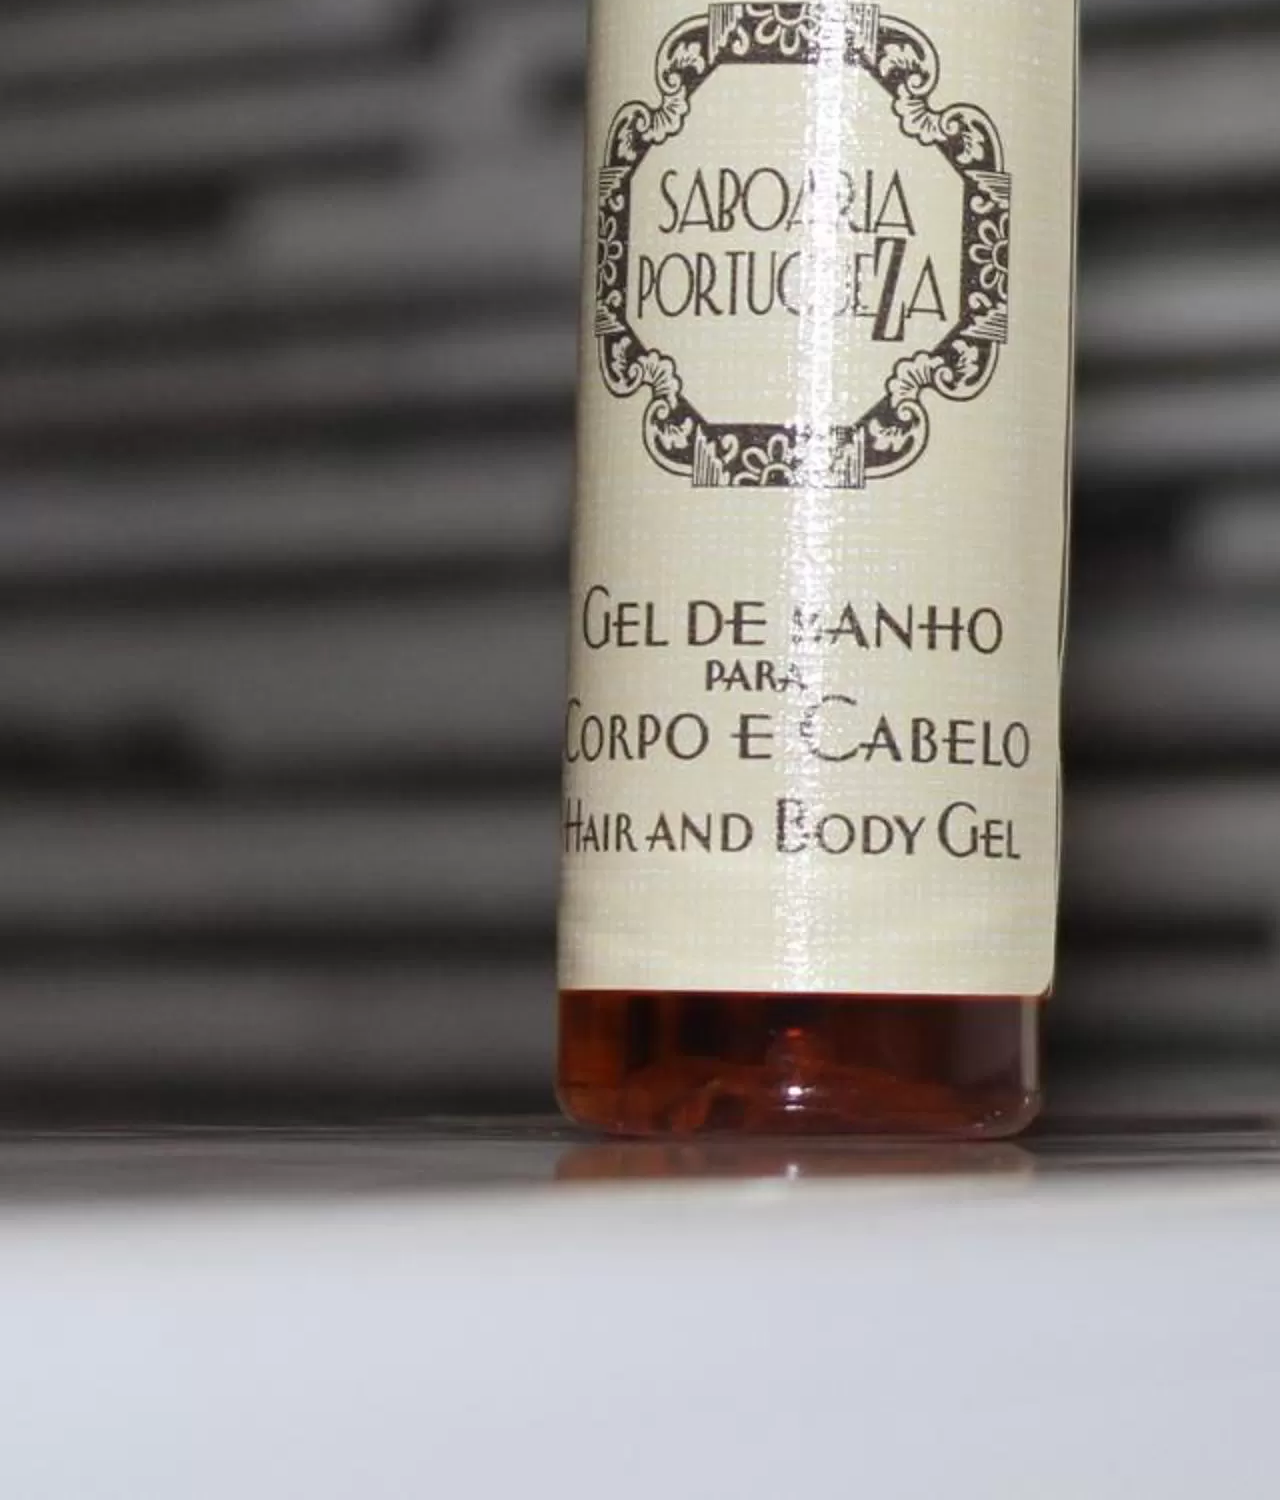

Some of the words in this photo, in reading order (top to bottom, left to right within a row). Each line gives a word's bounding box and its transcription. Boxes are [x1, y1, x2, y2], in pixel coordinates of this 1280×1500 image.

[659, 168, 916, 236] SABOARIA
[582, 584, 670, 649] GEL
[687, 600, 767, 646] DE
[704, 659, 808, 692] PARA
[564, 698, 709, 763] CORPO
[730, 713, 774, 761] E
[801, 695, 1030, 769] CABELO
[562, 798, 638, 854] HAIR
[646, 812, 754, 853] AND
[775, 798, 926, 856] BODY
[938, 801, 1022, 861] GEL
